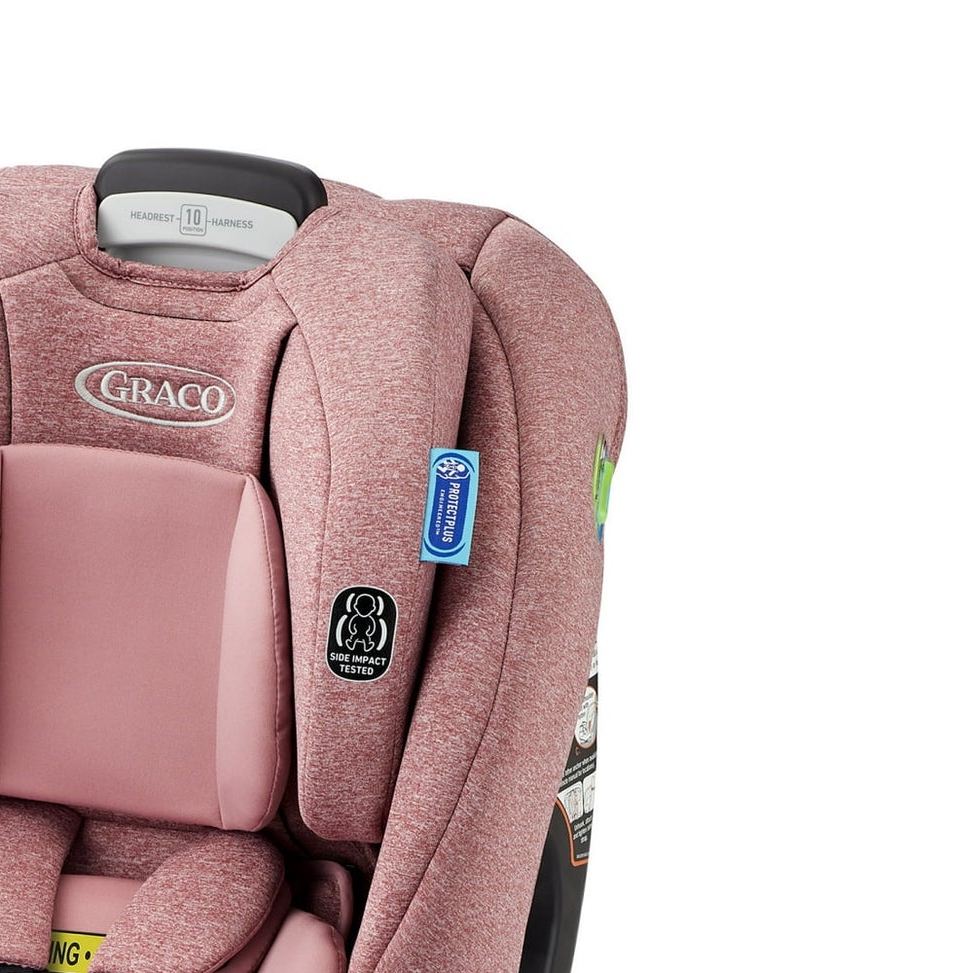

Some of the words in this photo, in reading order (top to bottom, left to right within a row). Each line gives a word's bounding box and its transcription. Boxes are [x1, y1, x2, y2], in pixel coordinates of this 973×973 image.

[130, 210, 175, 223] HEADREST
[186, 208, 201, 226] 10
[211, 217, 254, 229] HARNESS
[100, 369, 226, 415] GRACO
[329, 652, 351, 663] SIDE
[351, 654, 387, 666] IMPACT
[339, 664, 374, 676] TESTED
